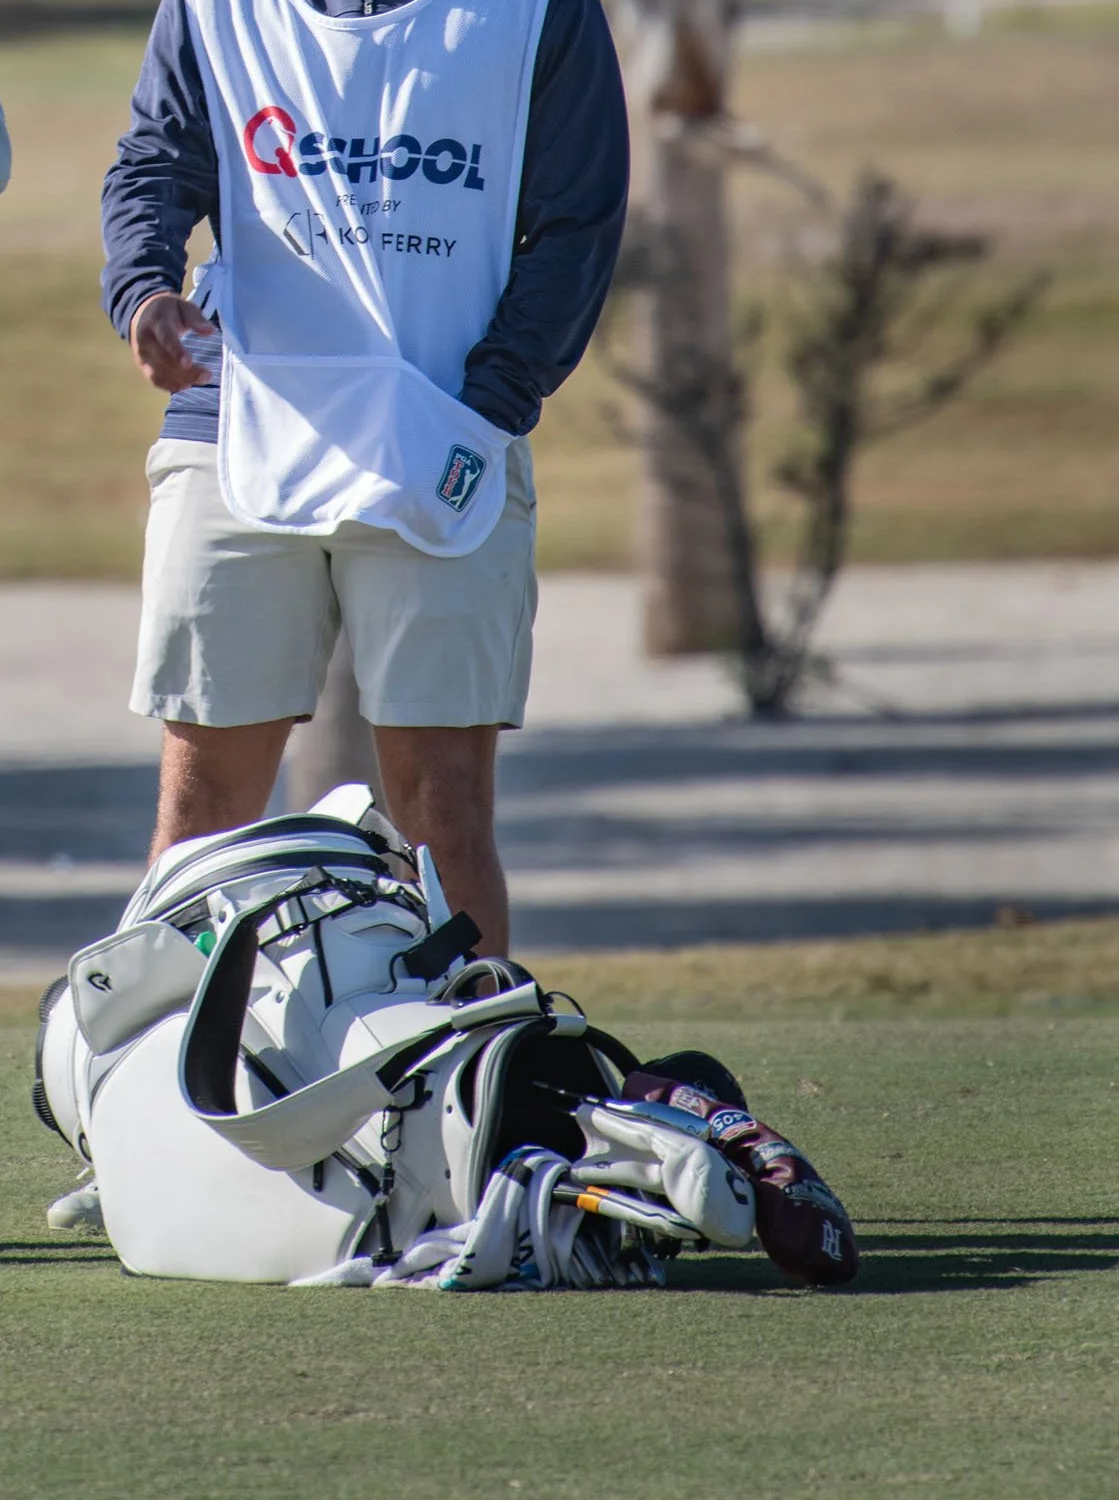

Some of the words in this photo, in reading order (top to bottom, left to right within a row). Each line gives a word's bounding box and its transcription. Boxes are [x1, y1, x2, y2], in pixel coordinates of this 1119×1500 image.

[382, 200, 401, 212] BY
[381, 232, 457, 257] FERRY
[456, 453, 471, 466] PGA
